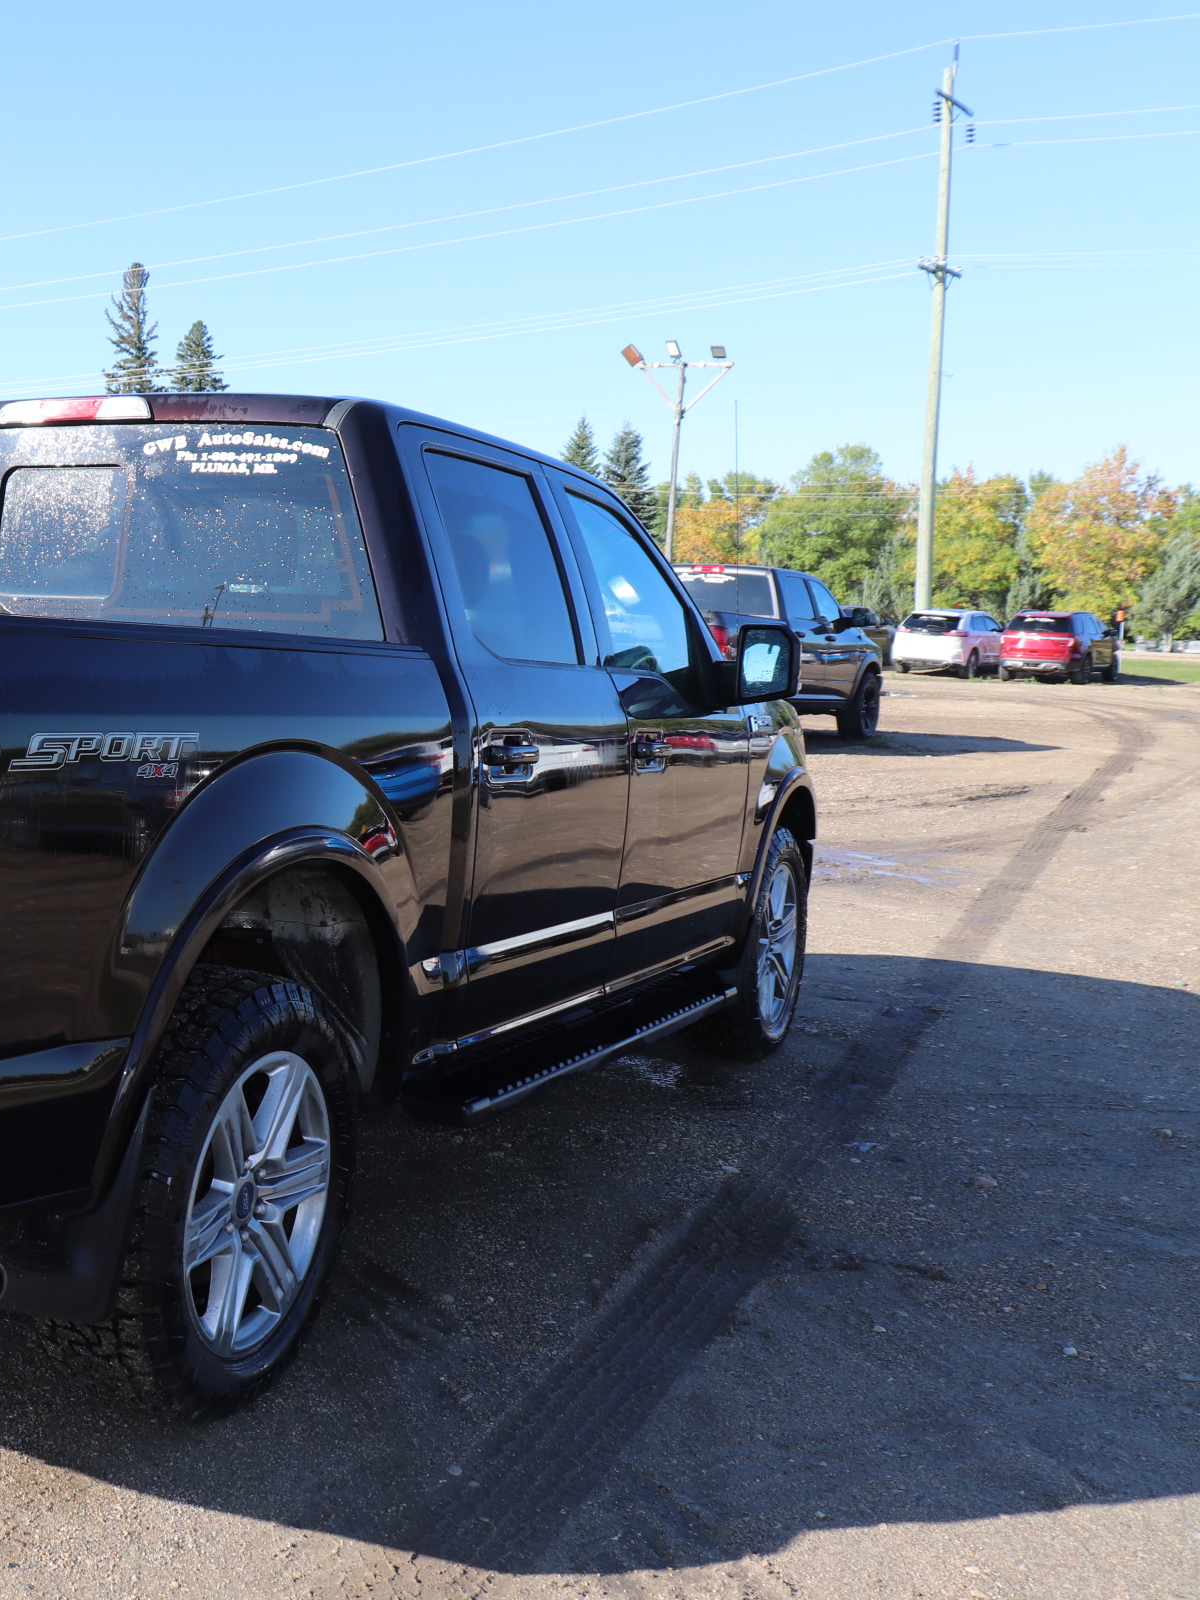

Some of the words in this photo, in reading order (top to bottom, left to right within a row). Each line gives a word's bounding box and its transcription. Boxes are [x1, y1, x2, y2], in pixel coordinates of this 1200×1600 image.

[143, 435, 187, 455] GWB
[197, 431, 330, 458] AutoSales.com
[191, 462, 250, 475] PLUMAS,
[8, 732, 199, 772] SPORT
